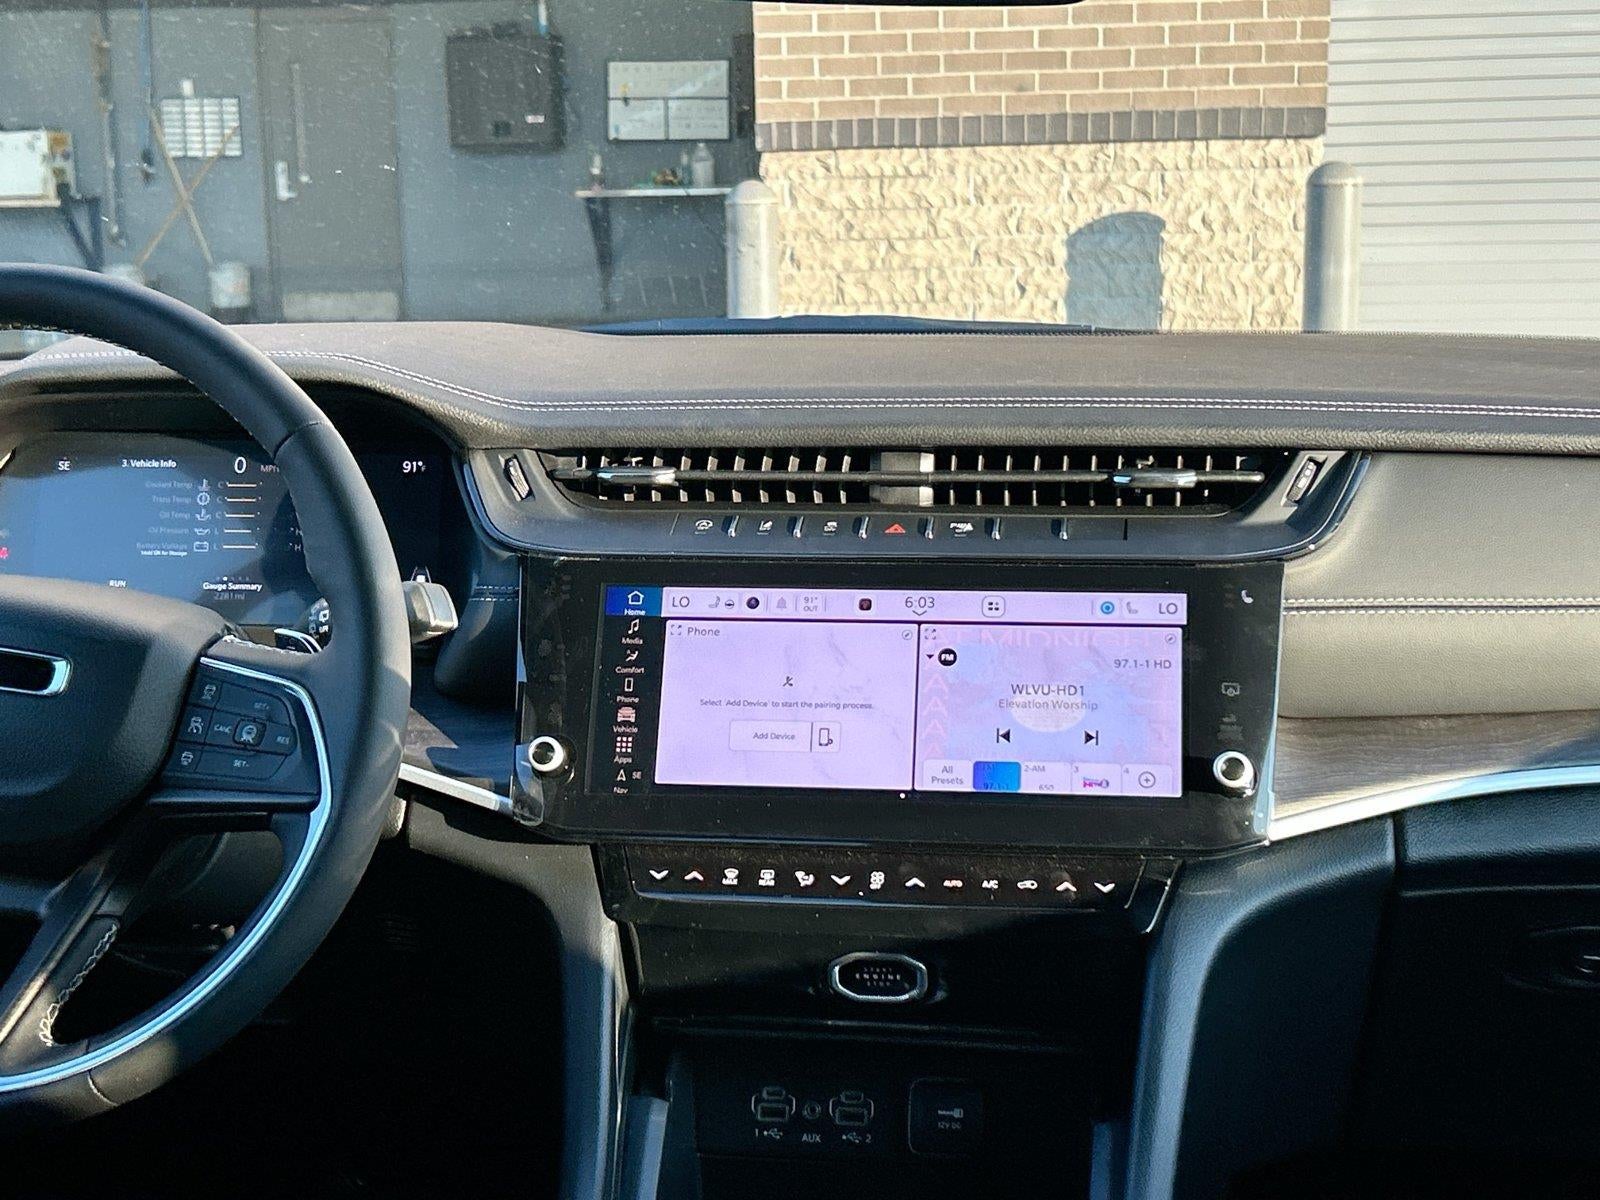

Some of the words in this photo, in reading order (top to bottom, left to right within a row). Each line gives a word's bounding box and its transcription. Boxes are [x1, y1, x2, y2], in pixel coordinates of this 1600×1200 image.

[58, 461, 71, 471] SE
[130, 459, 159, 468] Vehicle
[160, 459, 177, 468] Info
[234, 456, 247, 474] 0
[109, 579, 127, 588] RUN
[202, 582, 227, 591] Gauge
[228, 582, 262, 592] Summary
[671, 596, 690, 608] LO
[904, 596, 936, 609] 6:03
[624, 608, 646, 616] Home
[1158, 602, 1179, 615] LO
[687, 626, 721, 637] Phone
[621, 637, 643, 645] Media
[940, 652, 955, 662] FM
[1113, 658, 1151, 669] 97.1-1
[1154, 659, 1173, 670] HD
[615, 666, 645, 674] Comfort
[1010, 683, 1086, 697] WLVU-HD1
[616, 695, 639, 703] Phone
[700, 699, 722, 707] Select
[781, 701, 799, 709] start
[800, 701, 813, 709] the
[814, 701, 841, 711] pairing
[998, 698, 1048, 710] Elevation
[1050, 699, 1099, 712] Worship
[613, 725, 639, 733] Vehicle
[752, 732, 769, 741] Add
[770, 732, 796, 741] Device
[613, 756, 632, 765] Apps
[941, 765, 954, 774] All
[931, 776, 965, 785] Presets
[613, 786, 628, 794] Nav
[801, 1133, 822, 1144] AUX
